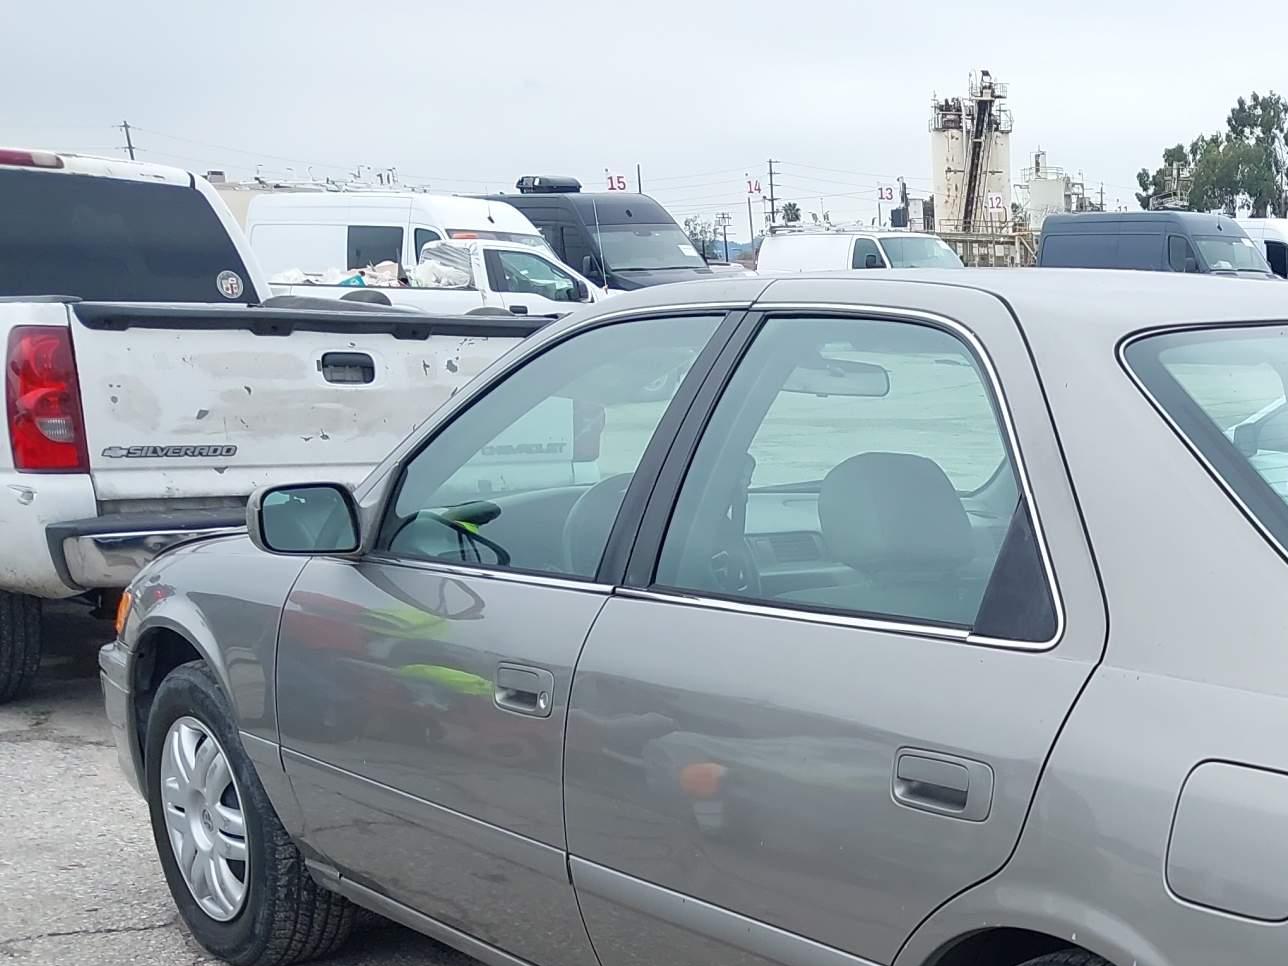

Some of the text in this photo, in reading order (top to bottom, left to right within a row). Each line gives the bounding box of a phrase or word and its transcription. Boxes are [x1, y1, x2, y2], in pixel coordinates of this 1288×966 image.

[607, 175, 626, 191] 15
[747, 180, 762, 194] 14
[877, 187, 894, 201] 13
[989, 196, 1002, 209] 12
[126, 445, 238, 458] SILVERADO
